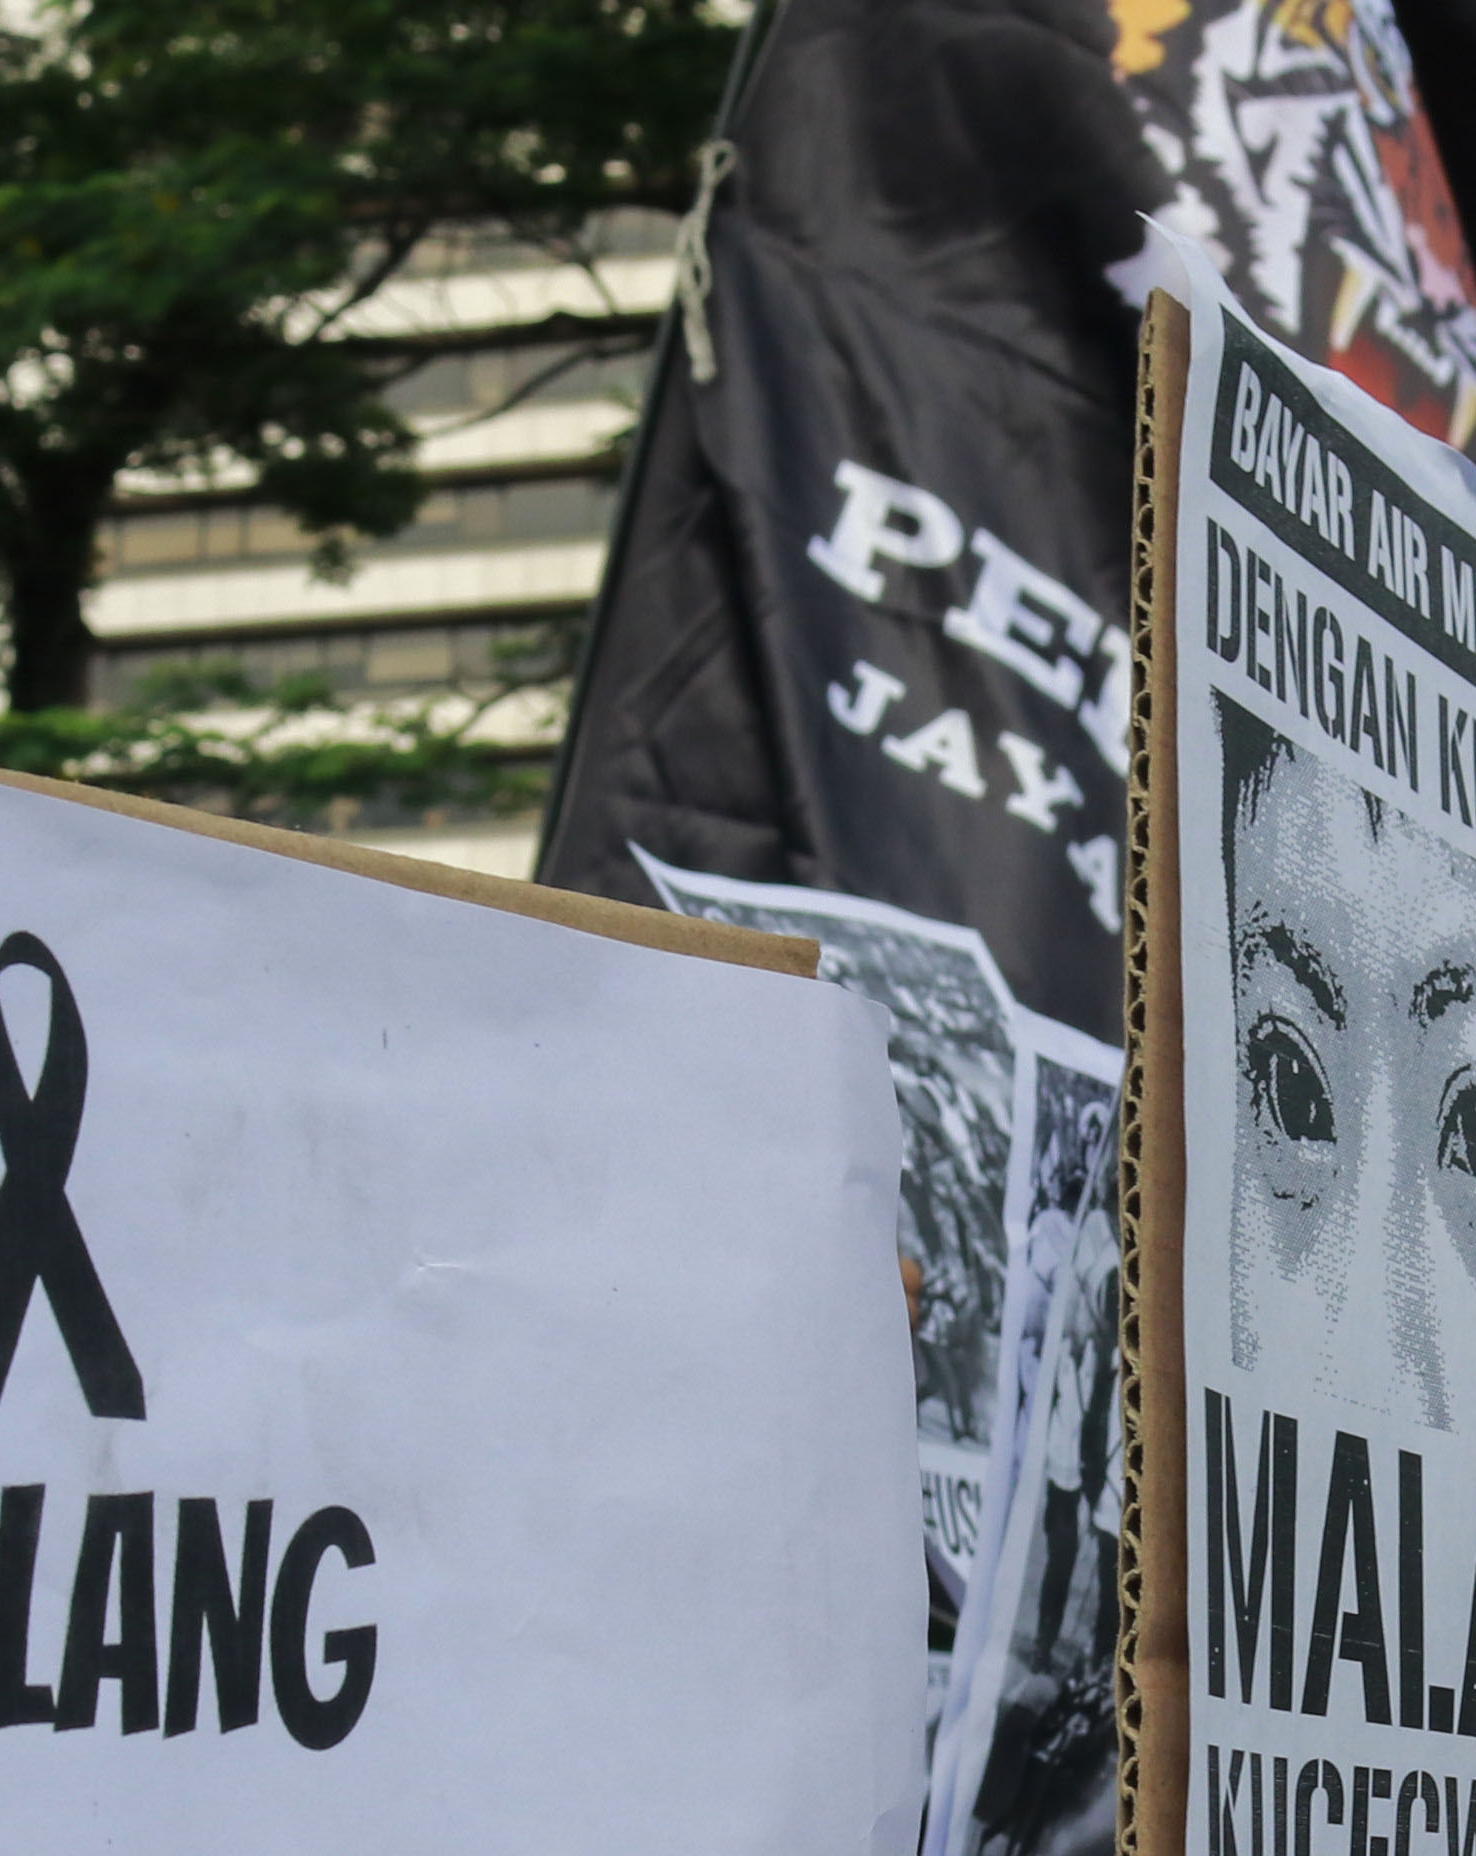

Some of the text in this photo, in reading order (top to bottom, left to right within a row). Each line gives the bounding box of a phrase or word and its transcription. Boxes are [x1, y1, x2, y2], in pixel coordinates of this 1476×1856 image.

[1230, 360, 1356, 561] BAYAR
[1366, 488, 1431, 621] AIR
[1206, 515, 1421, 794] DENGAN
